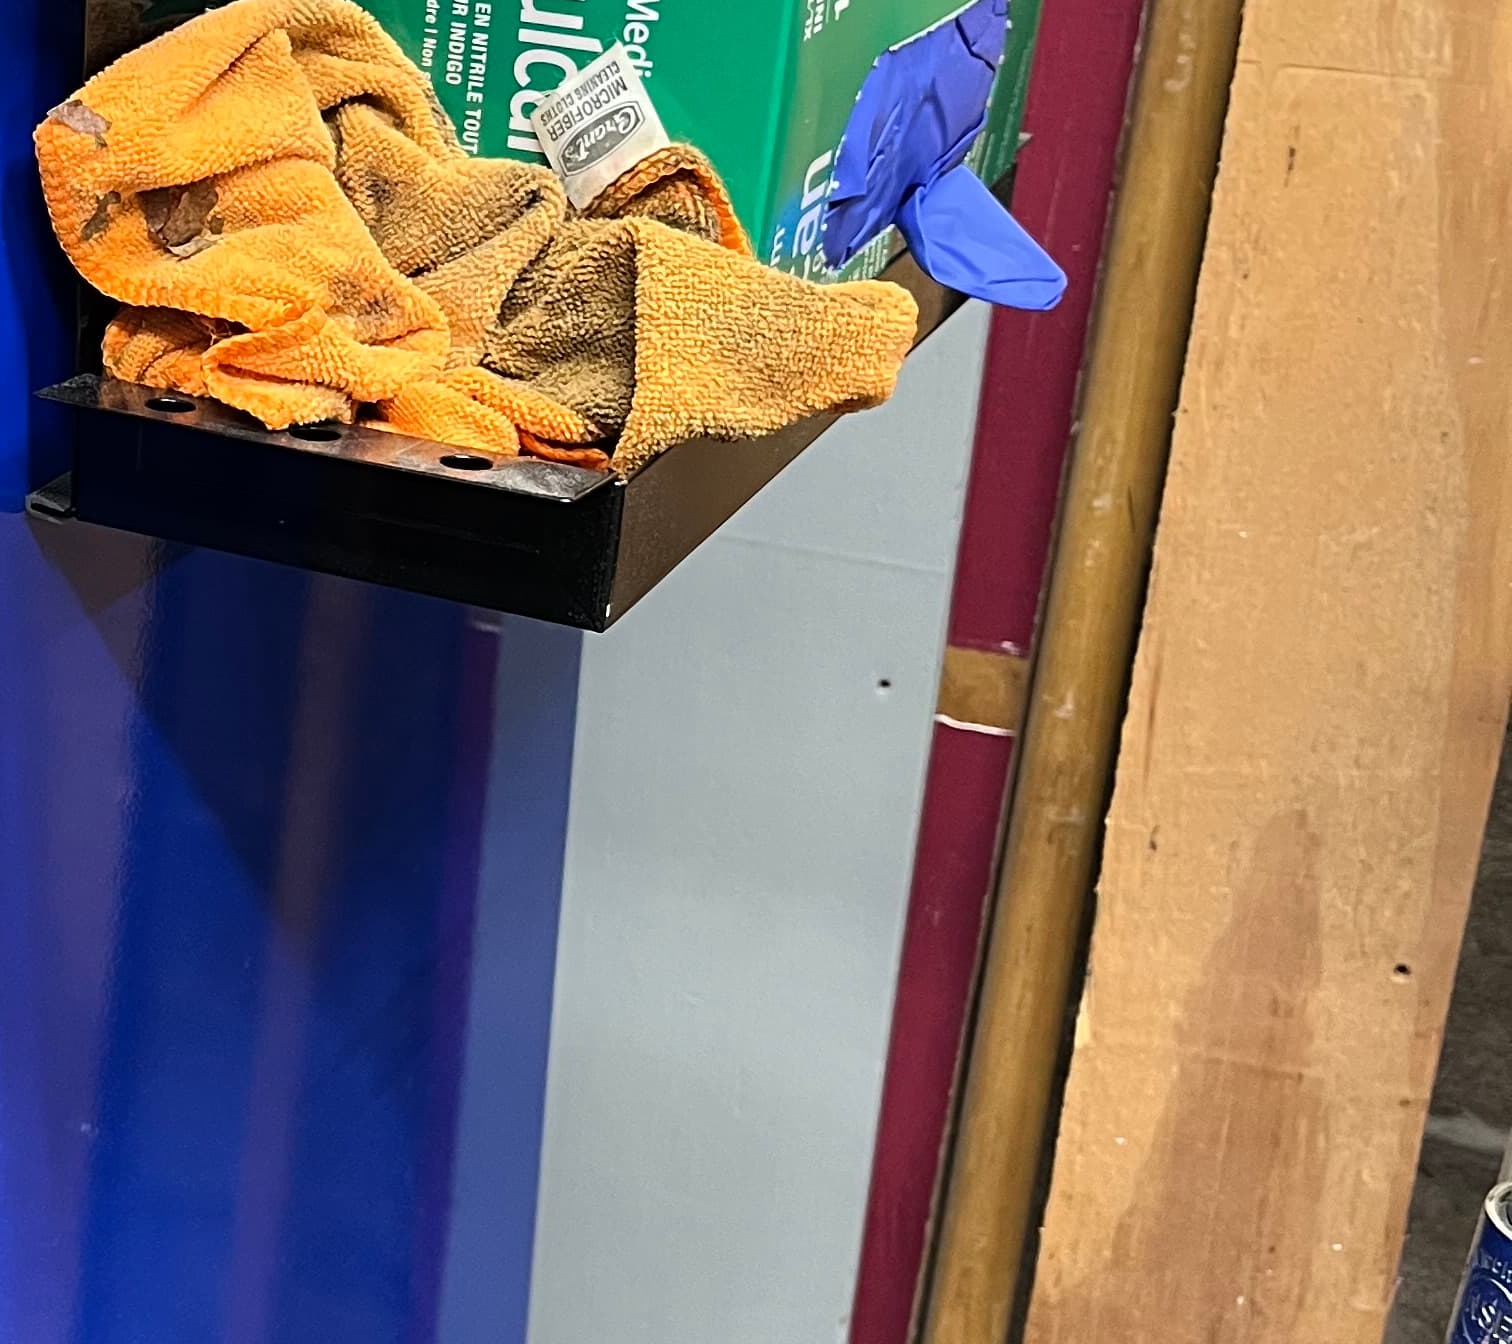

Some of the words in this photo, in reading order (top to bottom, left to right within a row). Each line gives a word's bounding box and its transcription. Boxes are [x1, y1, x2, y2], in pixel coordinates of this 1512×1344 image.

[473, 2, 492, 28] EN
[421, 37, 437, 67] Non
[445, 21, 467, 85] INDIGO
[466, 32, 489, 104] NITRILE
[574, 60, 621, 101] CLEANING
[462, 107, 481, 154] TOUT
[540, 92, 575, 126] CLOTHS
[546, 76, 628, 142] MICROFIBER
